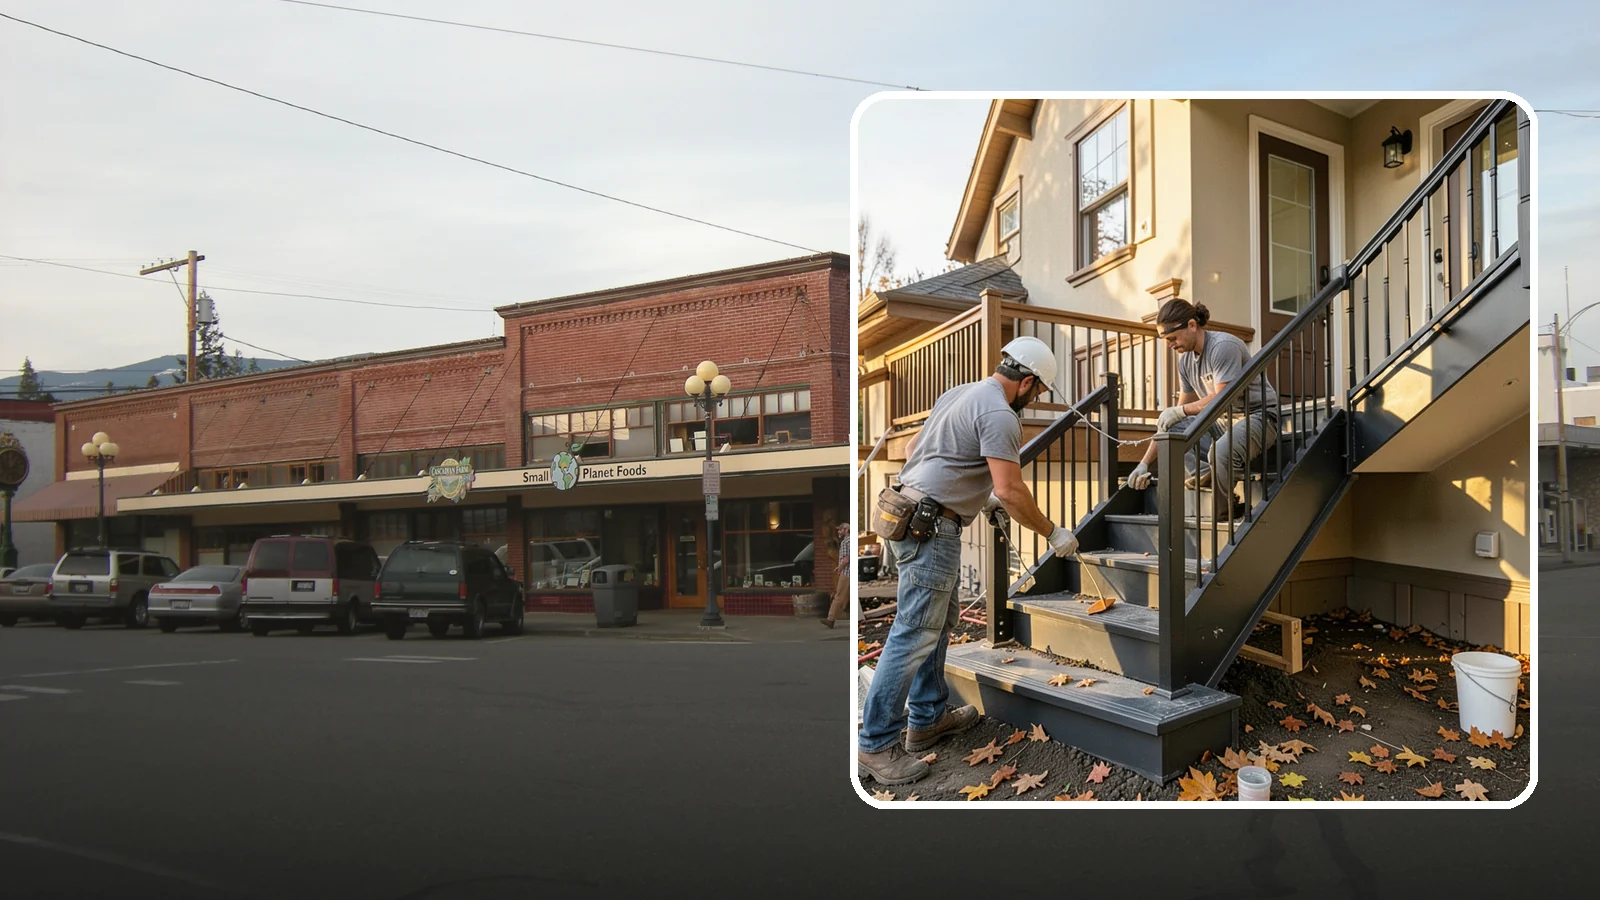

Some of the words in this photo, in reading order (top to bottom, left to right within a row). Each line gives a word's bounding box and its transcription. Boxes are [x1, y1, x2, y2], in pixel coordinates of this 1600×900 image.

[522, 470, 549, 483] Small
[582, 467, 614, 479] Planet
[616, 464, 647, 477] Foods
